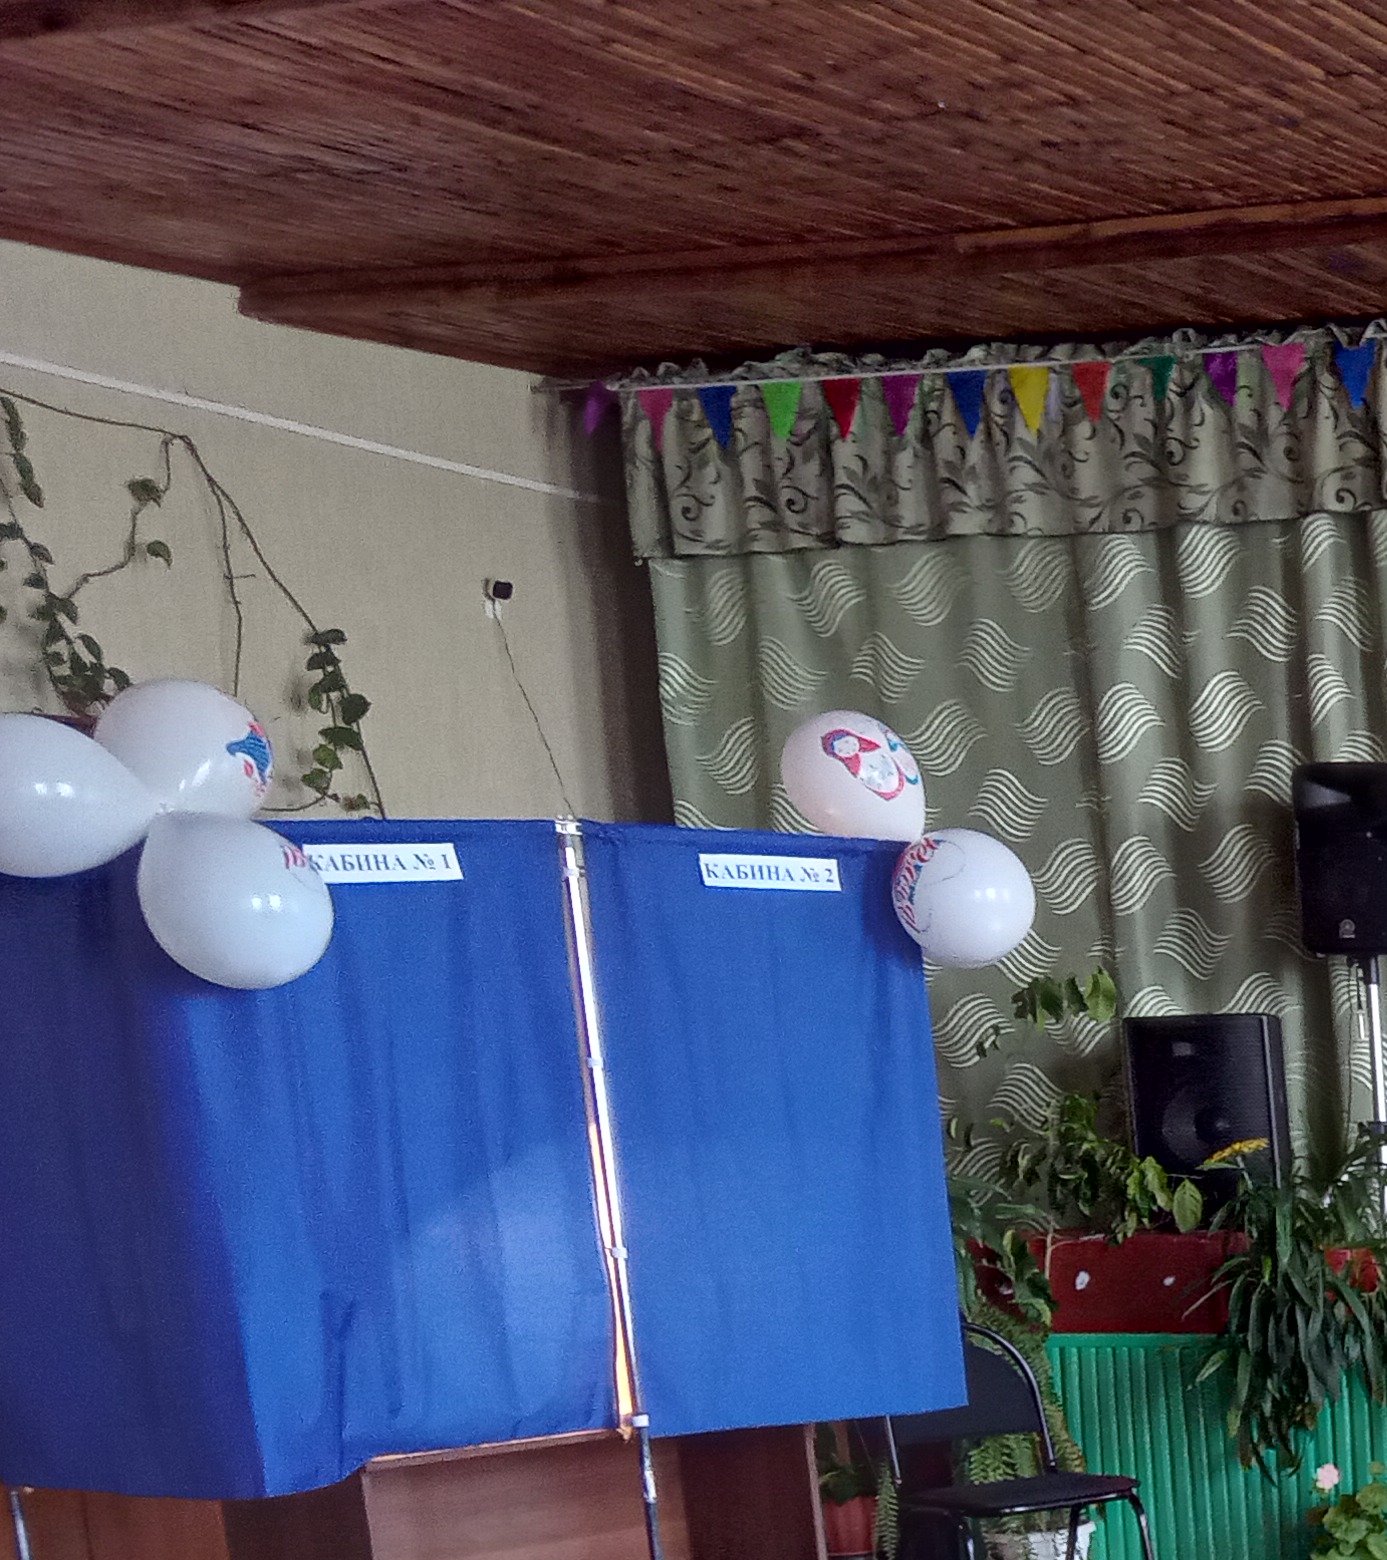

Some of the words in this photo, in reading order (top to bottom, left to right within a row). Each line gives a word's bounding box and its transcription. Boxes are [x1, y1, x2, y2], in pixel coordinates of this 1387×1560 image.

[308, 853, 407, 872] КАБИНА
[413, 853, 436, 870] №
[441, 853, 452, 869] 1
[703, 863, 795, 882] КАБИНА
[800, 866, 820, 882] №
[825, 868, 834, 882] 2
